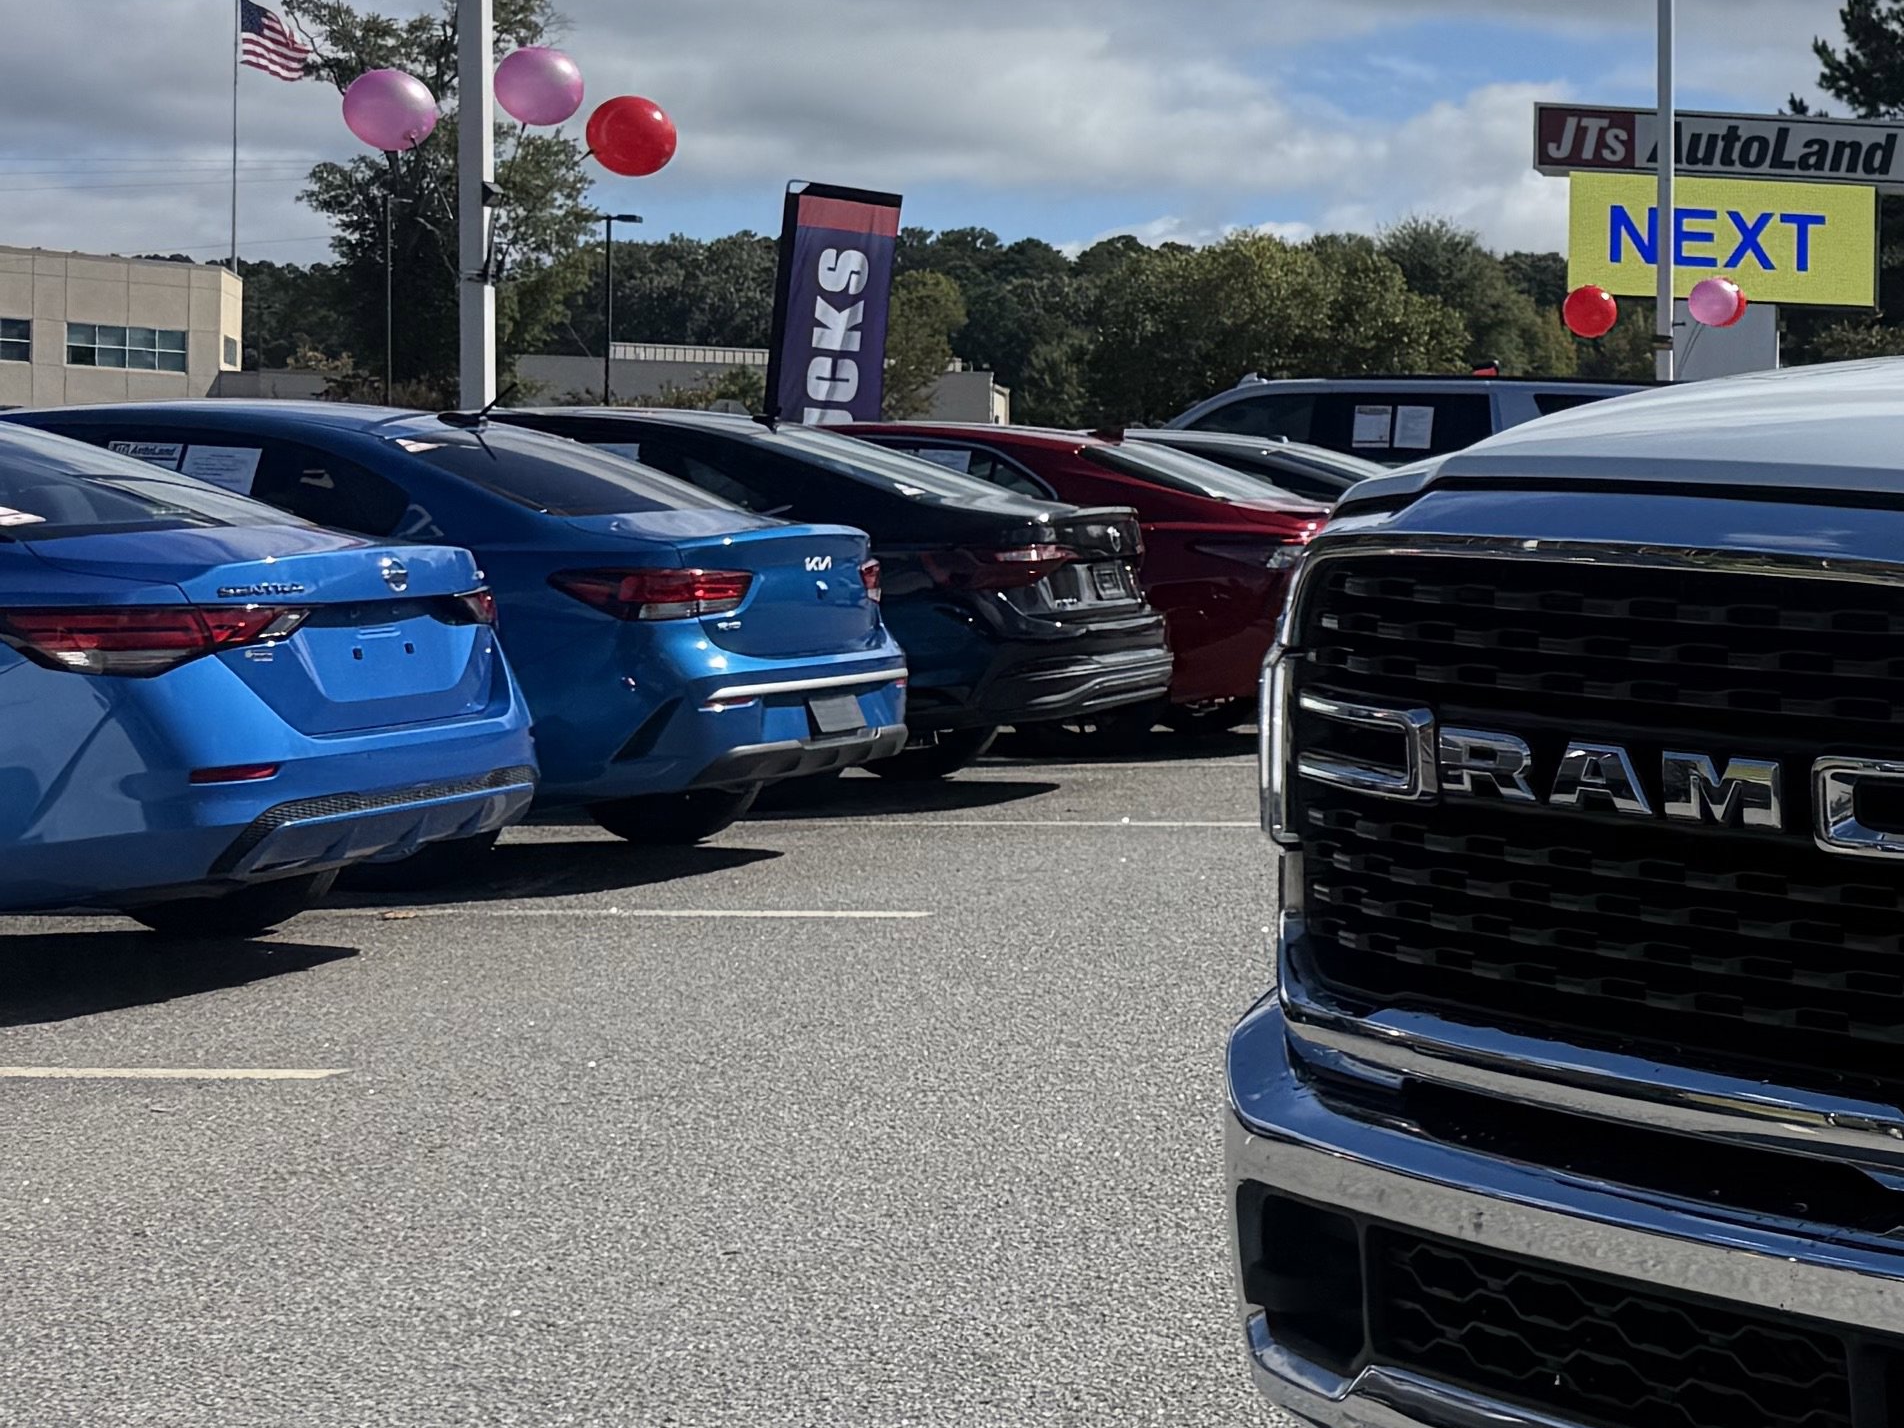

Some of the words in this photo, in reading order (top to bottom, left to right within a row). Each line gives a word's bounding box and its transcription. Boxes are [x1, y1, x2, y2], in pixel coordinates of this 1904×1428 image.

[1546, 116, 1629, 163] JTs
[1609, 205, 1827, 273] NEXT
[1438, 726, 1783, 830] RAM
